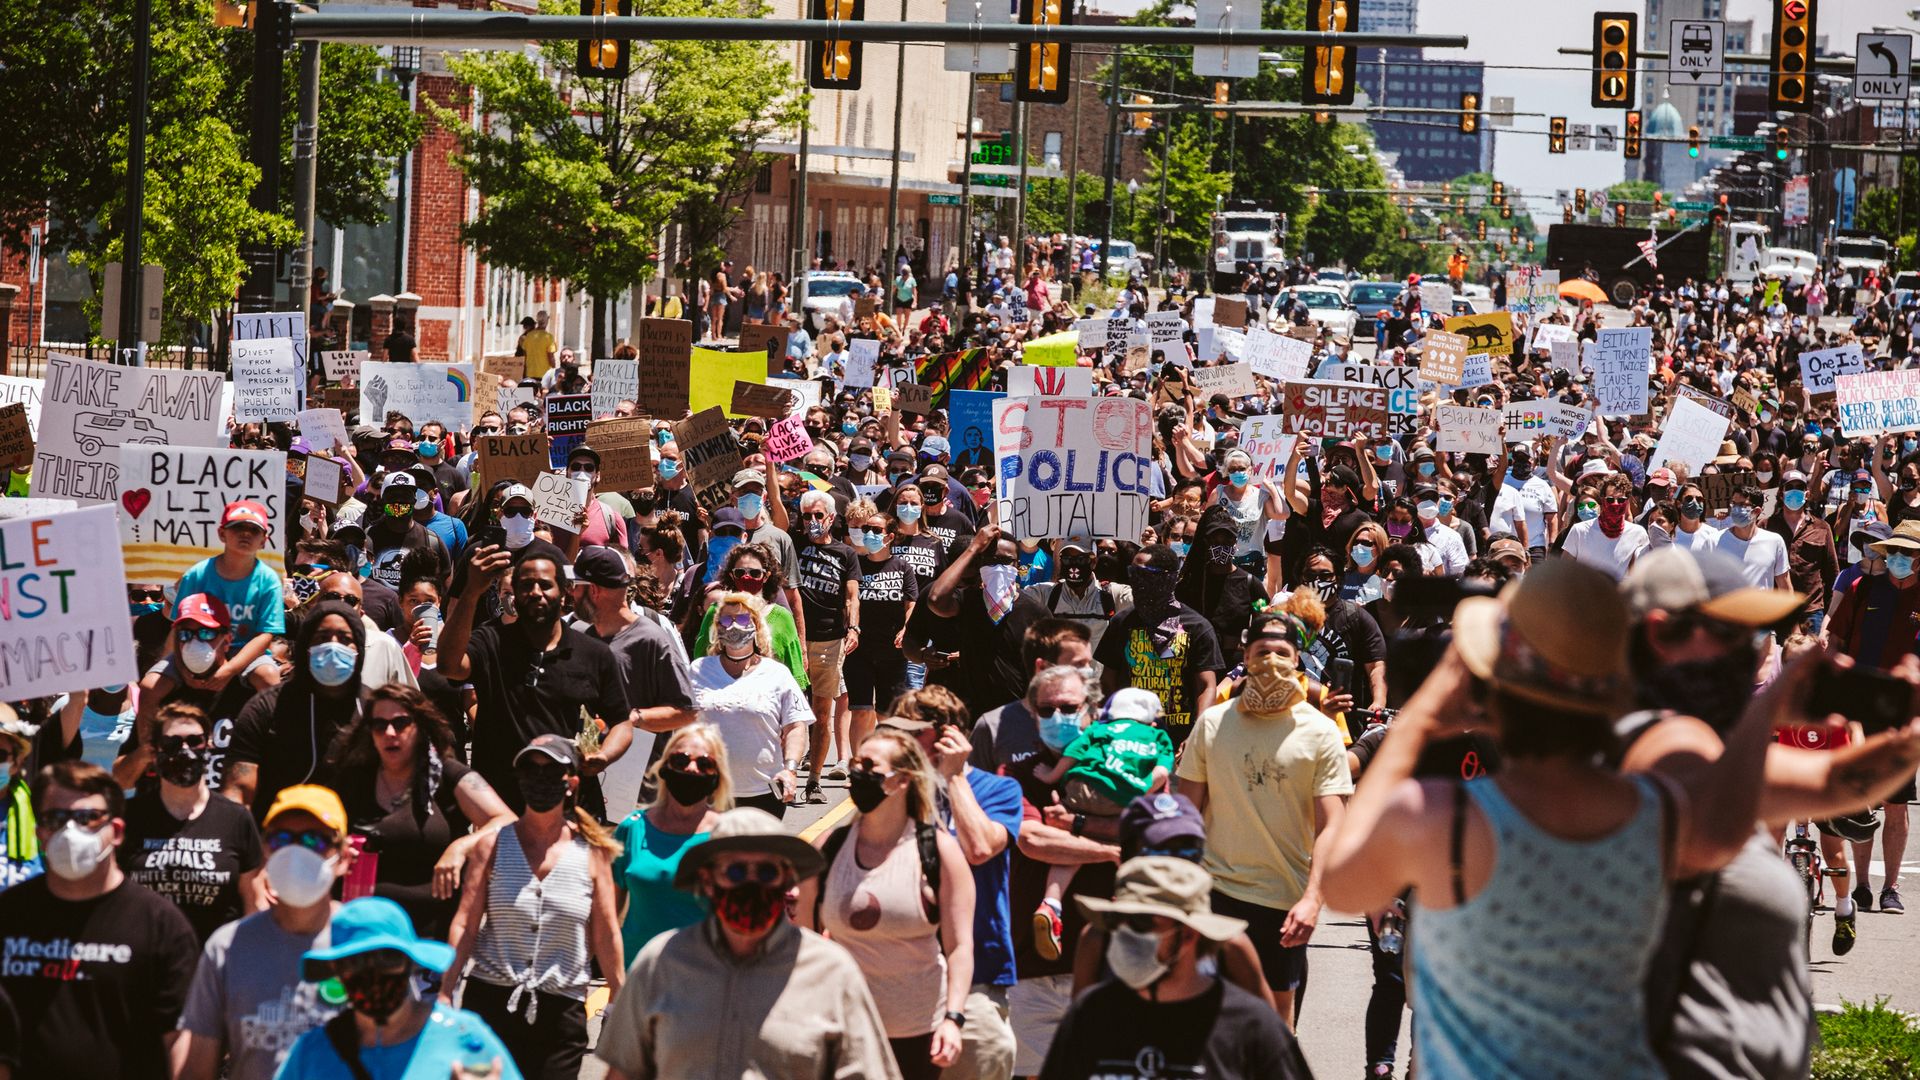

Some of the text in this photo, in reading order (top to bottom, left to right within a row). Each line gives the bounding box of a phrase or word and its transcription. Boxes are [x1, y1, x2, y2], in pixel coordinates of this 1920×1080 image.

[1680, 55, 1712, 67] ONLY
[1862, 81, 1902, 95] ONLY
[236, 317, 303, 340] MAKE
[1107, 319, 1129, 327] STOP
[1148, 321, 1163, 329] HOW
[1428, 341, 1464, 352] BRUTALITY
[1449, 336, 1462, 345] THE
[1603, 333, 1639, 348] BITCH
[1613, 349, 1649, 360] TURNED
[1809, 352, 1860, 372] One Is
[1422, 368, 1459, 381] EQUALITY
[1439, 364, 1457, 373] NEED
[1619, 361, 1647, 372] TWICE
[1344, 367, 1415, 389] BLACK
[1604, 374, 1633, 386] CAUSE
[1860, 373, 1881, 387] THAN
[51, 359, 222, 421] TAKE AWAY
[238, 387, 292, 397] INVEST IN
[901, 388, 930, 402] ACAB
[1597, 386, 1641, 402] FUCK 12
[1838, 384, 1919, 403] BLACK LIVES ARE
[243, 397, 281, 406] PUBLIC
[548, 400, 591, 413] BLACK
[1304, 387, 1386, 411] SILENCE
[1606, 401, 1641, 412] #ACAB
[244, 408, 297, 417] EDUCATION
[1560, 408, 1586, 421] WITCHES
[1841, 398, 1917, 418] NEEDED BELOVED
[1441, 407, 1476, 426] Black
[1000, 400, 1151, 453] STOP
[1291, 414, 1383, 439] VIOLENCE
[488, 438, 540, 457] BLACK
[773, 432, 801, 449] LIVES
[769, 440, 810, 461] MATTER
[37, 452, 120, 500] THEIR
[151, 452, 270, 489] BLACK
[1000, 449, 1150, 498] POLICE
[539, 475, 573, 496] OUR
[546, 497, 583, 514] LIVES
[1000, 493, 1150, 538] BRUTALITY
[799, 558, 841, 580] LIVES
[1131, 677, 1171, 690] NATURAL
[177, 837, 222, 852] SILENCE
[145, 850, 216, 870] EQUALS
[131, 870, 168, 882] WHITE
[3, 938, 133, 963] Medicare
[2, 957, 42, 977] for
